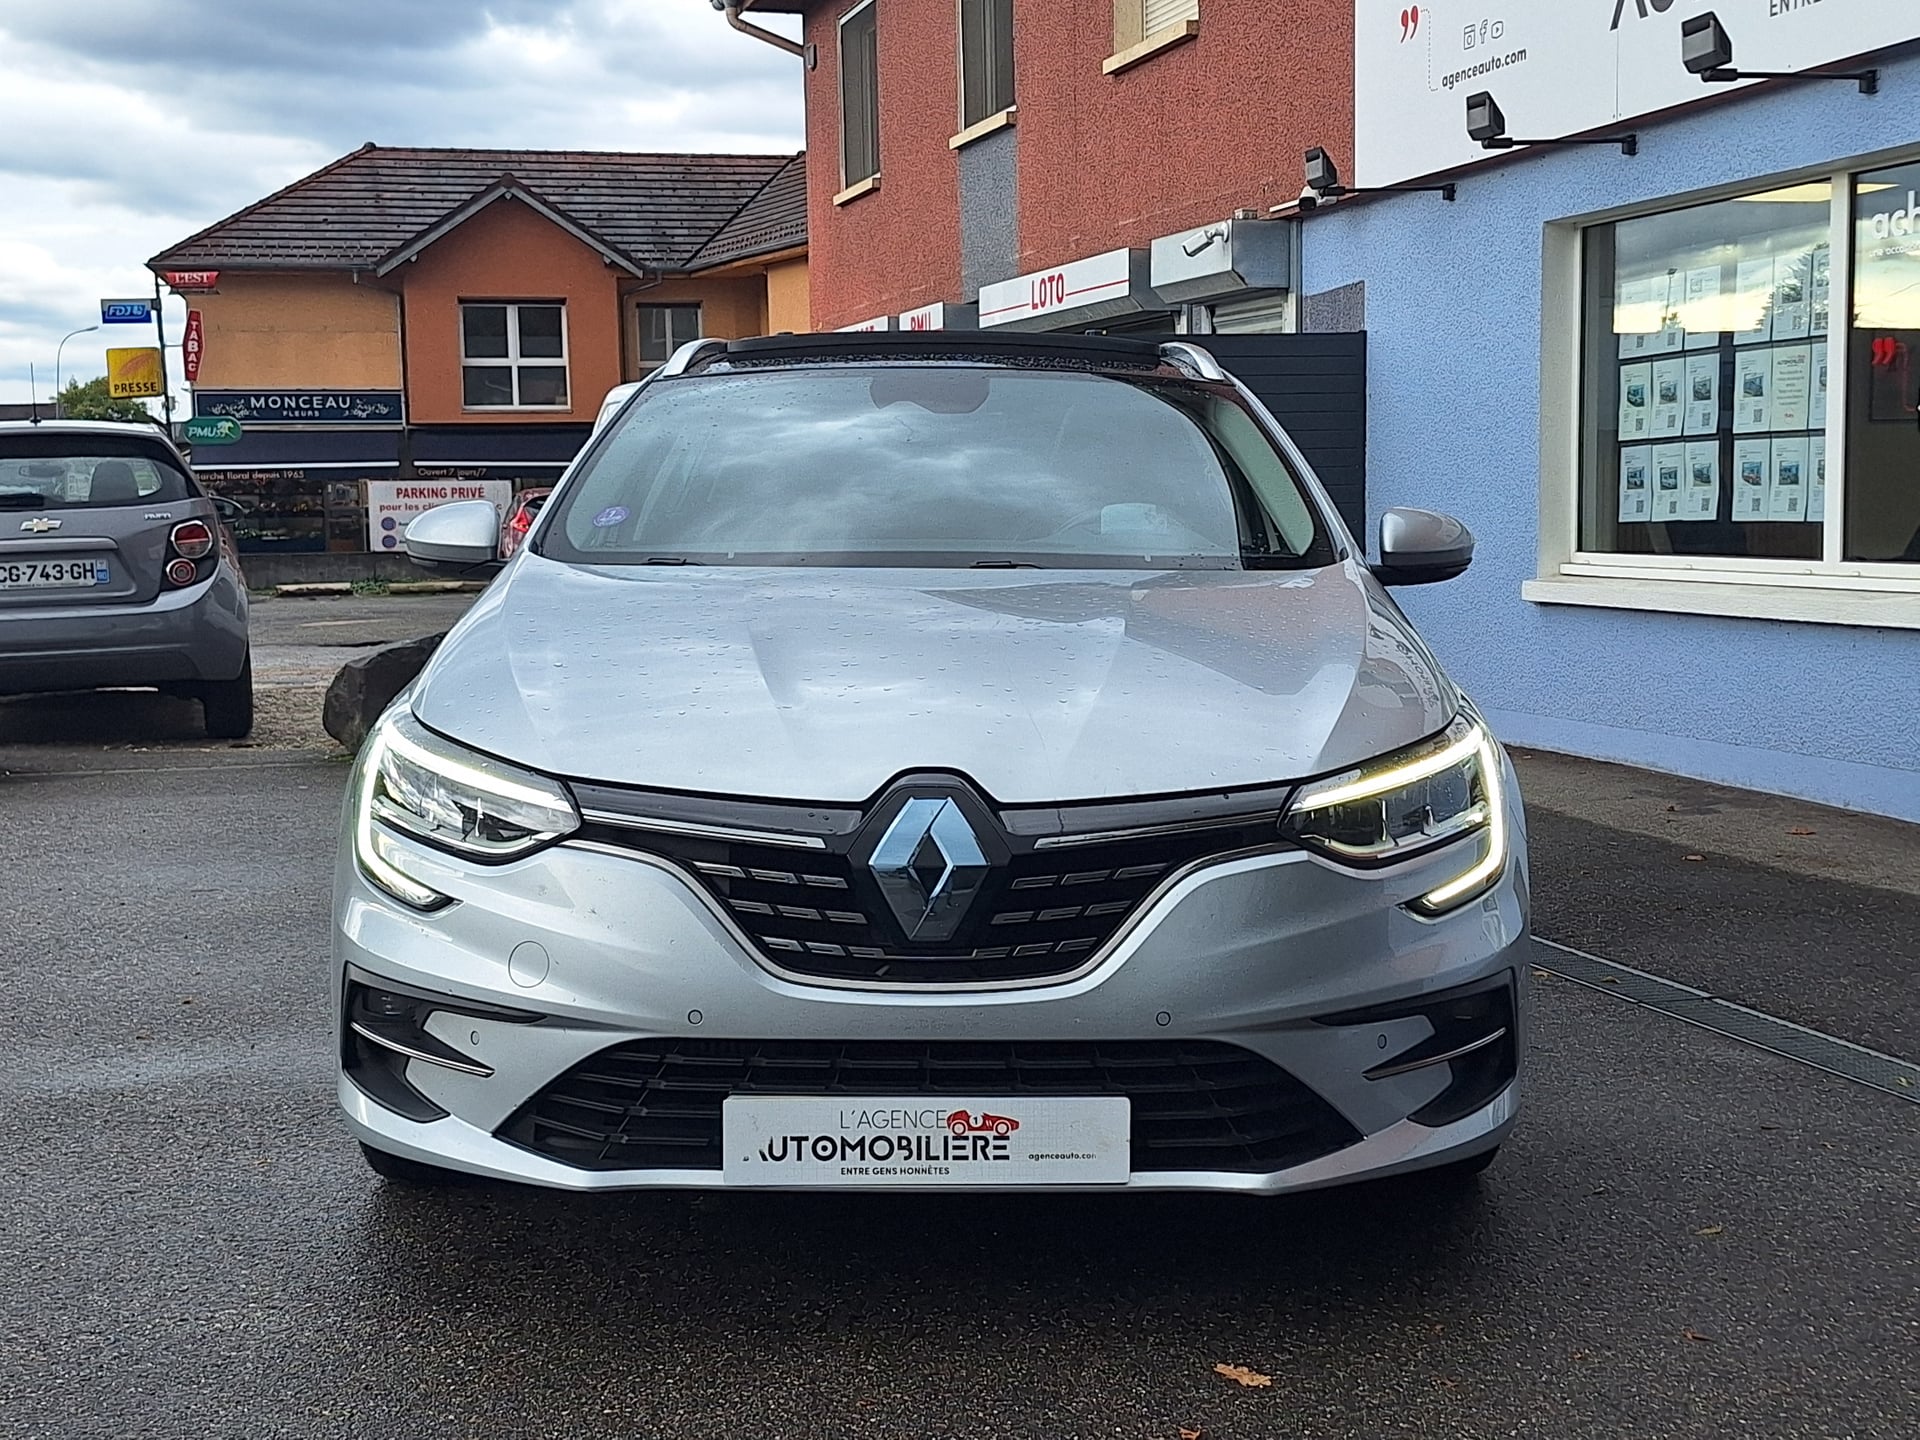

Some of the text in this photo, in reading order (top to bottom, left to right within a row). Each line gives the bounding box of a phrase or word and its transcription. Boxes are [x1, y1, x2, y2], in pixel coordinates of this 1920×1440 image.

[1441, 48, 1526, 90] agenceauto.com
[174, 272, 209, 284] L'EST
[1031, 272, 1064, 310] LOTO
[108, 305, 132, 316] FDJ
[187, 321, 199, 372] TABAC
[113, 382, 157, 394] PRESSE
[250, 396, 350, 409] MONCEAU
[188, 426, 217, 438] PMU
[227, 471, 250, 480] floral
[252, 470, 280, 482] depuis
[418, 468, 447, 476] Ouvert
[448, 468, 455, 476] 7
[396, 484, 485, 499] PARKING PRIVÉ
[379, 504, 402, 513] pour
[405, 503, 419, 511] les
[840, 1109, 947, 1129] L'AGENCE
[840, 1164, 950, 1175] ENTRE GENS HONNÊTES
